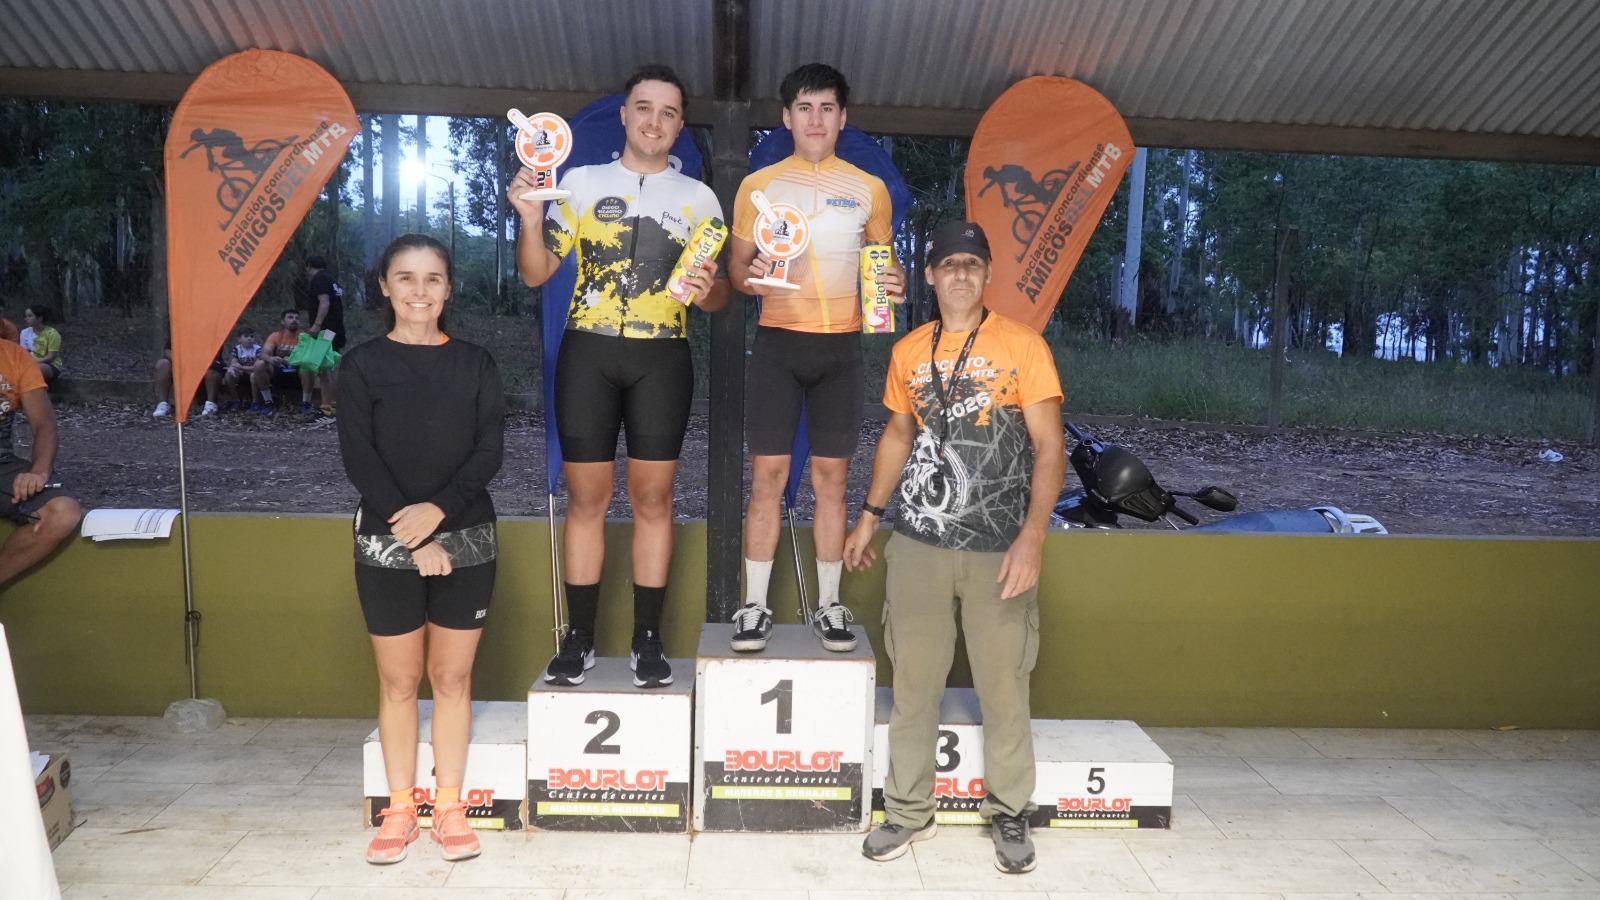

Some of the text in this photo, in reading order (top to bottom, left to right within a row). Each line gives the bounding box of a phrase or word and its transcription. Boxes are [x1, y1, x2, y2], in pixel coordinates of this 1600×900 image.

[218, 121, 329, 262] Asociación concordiense
[1016, 143, 1104, 293] Asociación concordiense
[917, 357, 986, 374] CICUTO
[909, 373, 948, 387] AMIGS
[970, 368, 995, 378] MTB
[761, 679, 793, 734] 1
[583, 710, 621, 755] 2
[724, 750, 843, 772] BOURLOT
[935, 730, 961, 773] 3
[548, 768, 669, 791] BOURLOT
[724, 774, 838, 784] Centro de cortes
[1087, 767, 1106, 795] 5
[412, 787, 495, 807] OUOT
[548, 791, 665, 801] Centro de cortes
[725, 789, 838, 798] MADERAS & HERRAJES
[1057, 798, 1132, 811] BOURLOT
